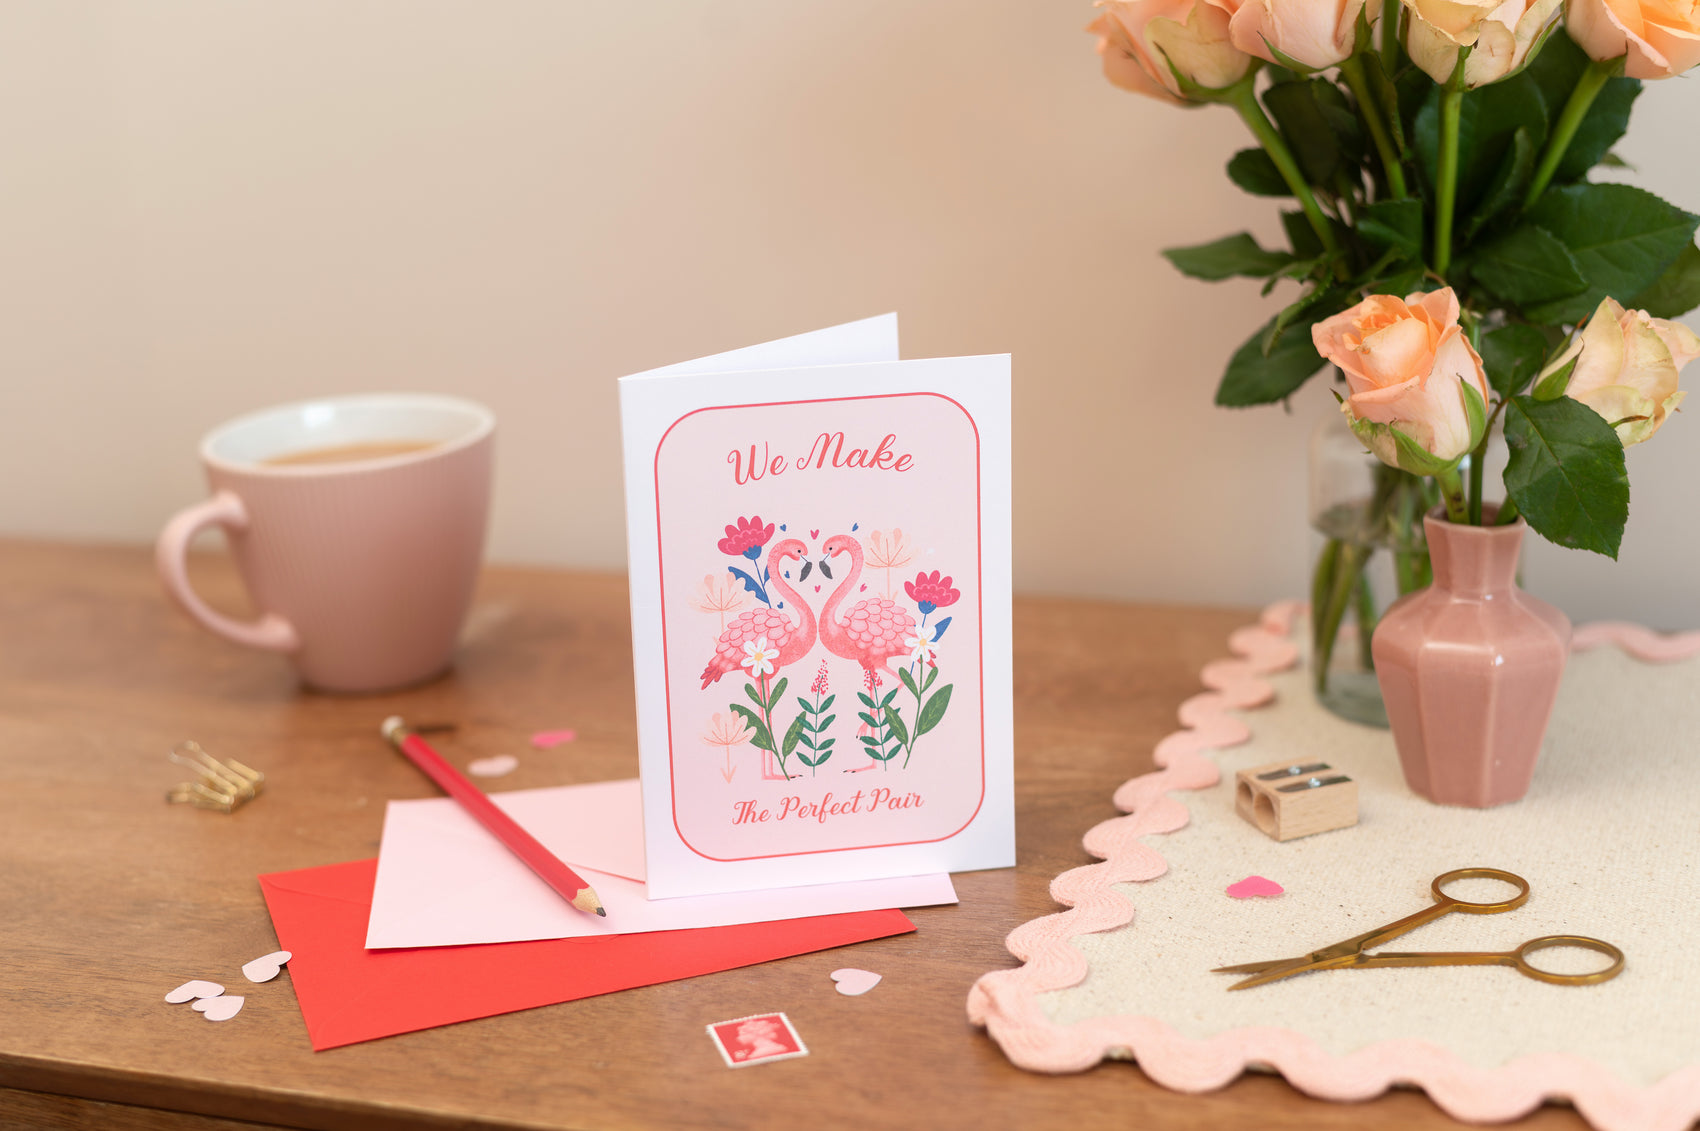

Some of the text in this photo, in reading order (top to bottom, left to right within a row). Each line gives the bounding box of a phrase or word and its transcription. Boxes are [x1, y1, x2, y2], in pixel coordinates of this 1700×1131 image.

[726, 431, 915, 486] We Make
[731, 787, 925, 826] The Perfect Pair
